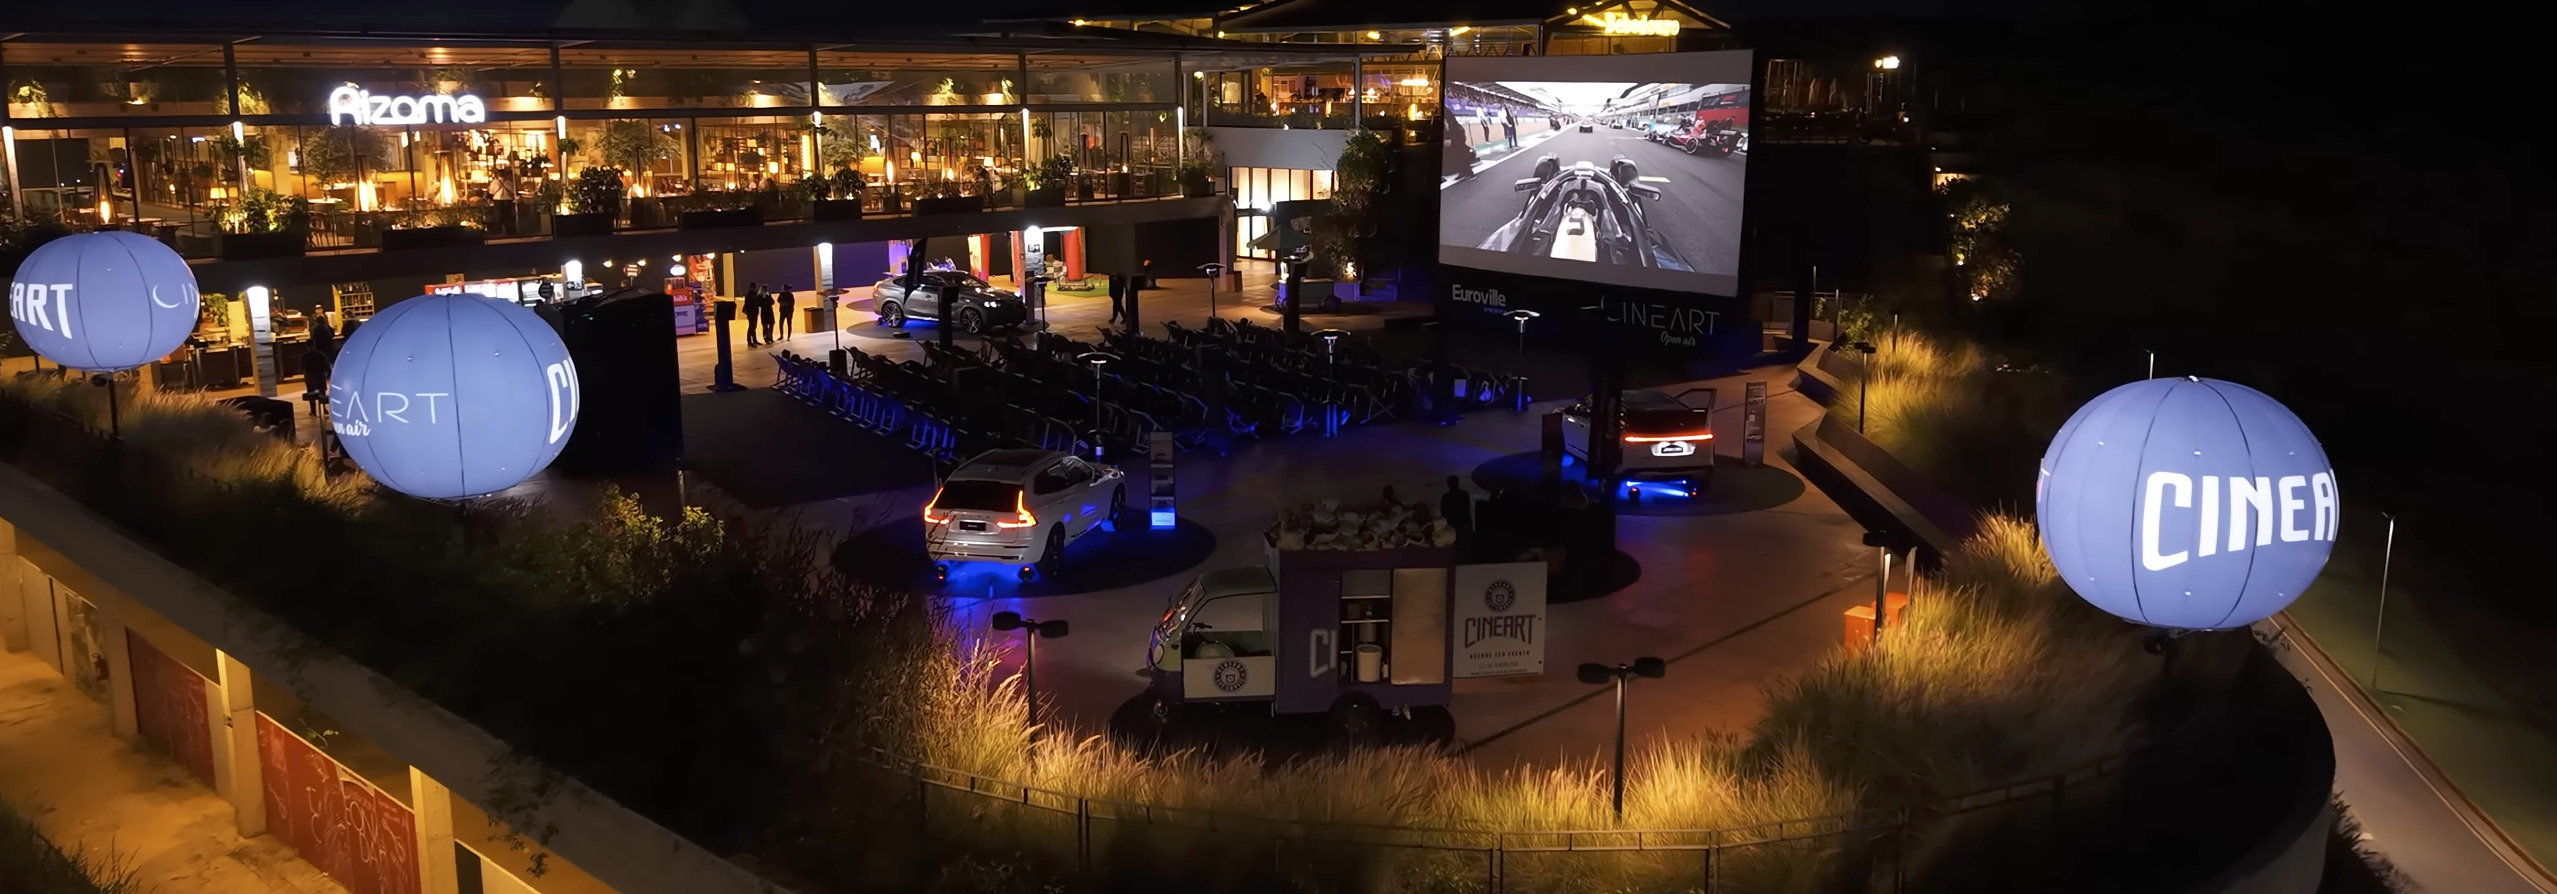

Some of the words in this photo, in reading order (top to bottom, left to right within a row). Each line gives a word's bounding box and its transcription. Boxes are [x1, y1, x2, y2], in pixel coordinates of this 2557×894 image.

[330, 86, 485, 125] Rizoma
[1452, 284, 1507, 306] Euroville
[1660, 331, 1681, 347] Open
[547, 355, 580, 444] CI
[346, 419, 371, 437] air
[2142, 468, 2340, 571] CINEA
[1465, 614, 1537, 649] CINEART
